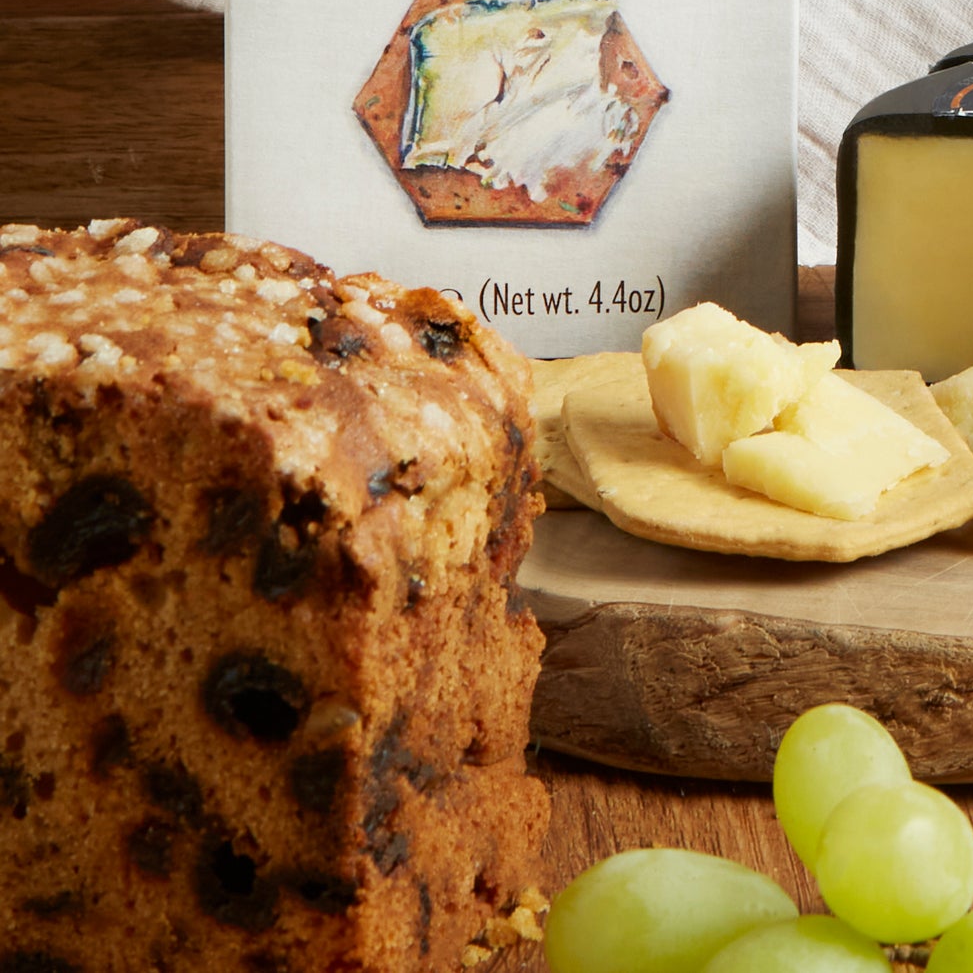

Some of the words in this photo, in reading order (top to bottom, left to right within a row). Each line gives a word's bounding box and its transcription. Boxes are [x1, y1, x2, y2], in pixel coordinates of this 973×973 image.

[479, 278, 535, 322] (Net
[543, 287, 579, 314] wt.
[588, 276, 665, 320] 4.4oz)
